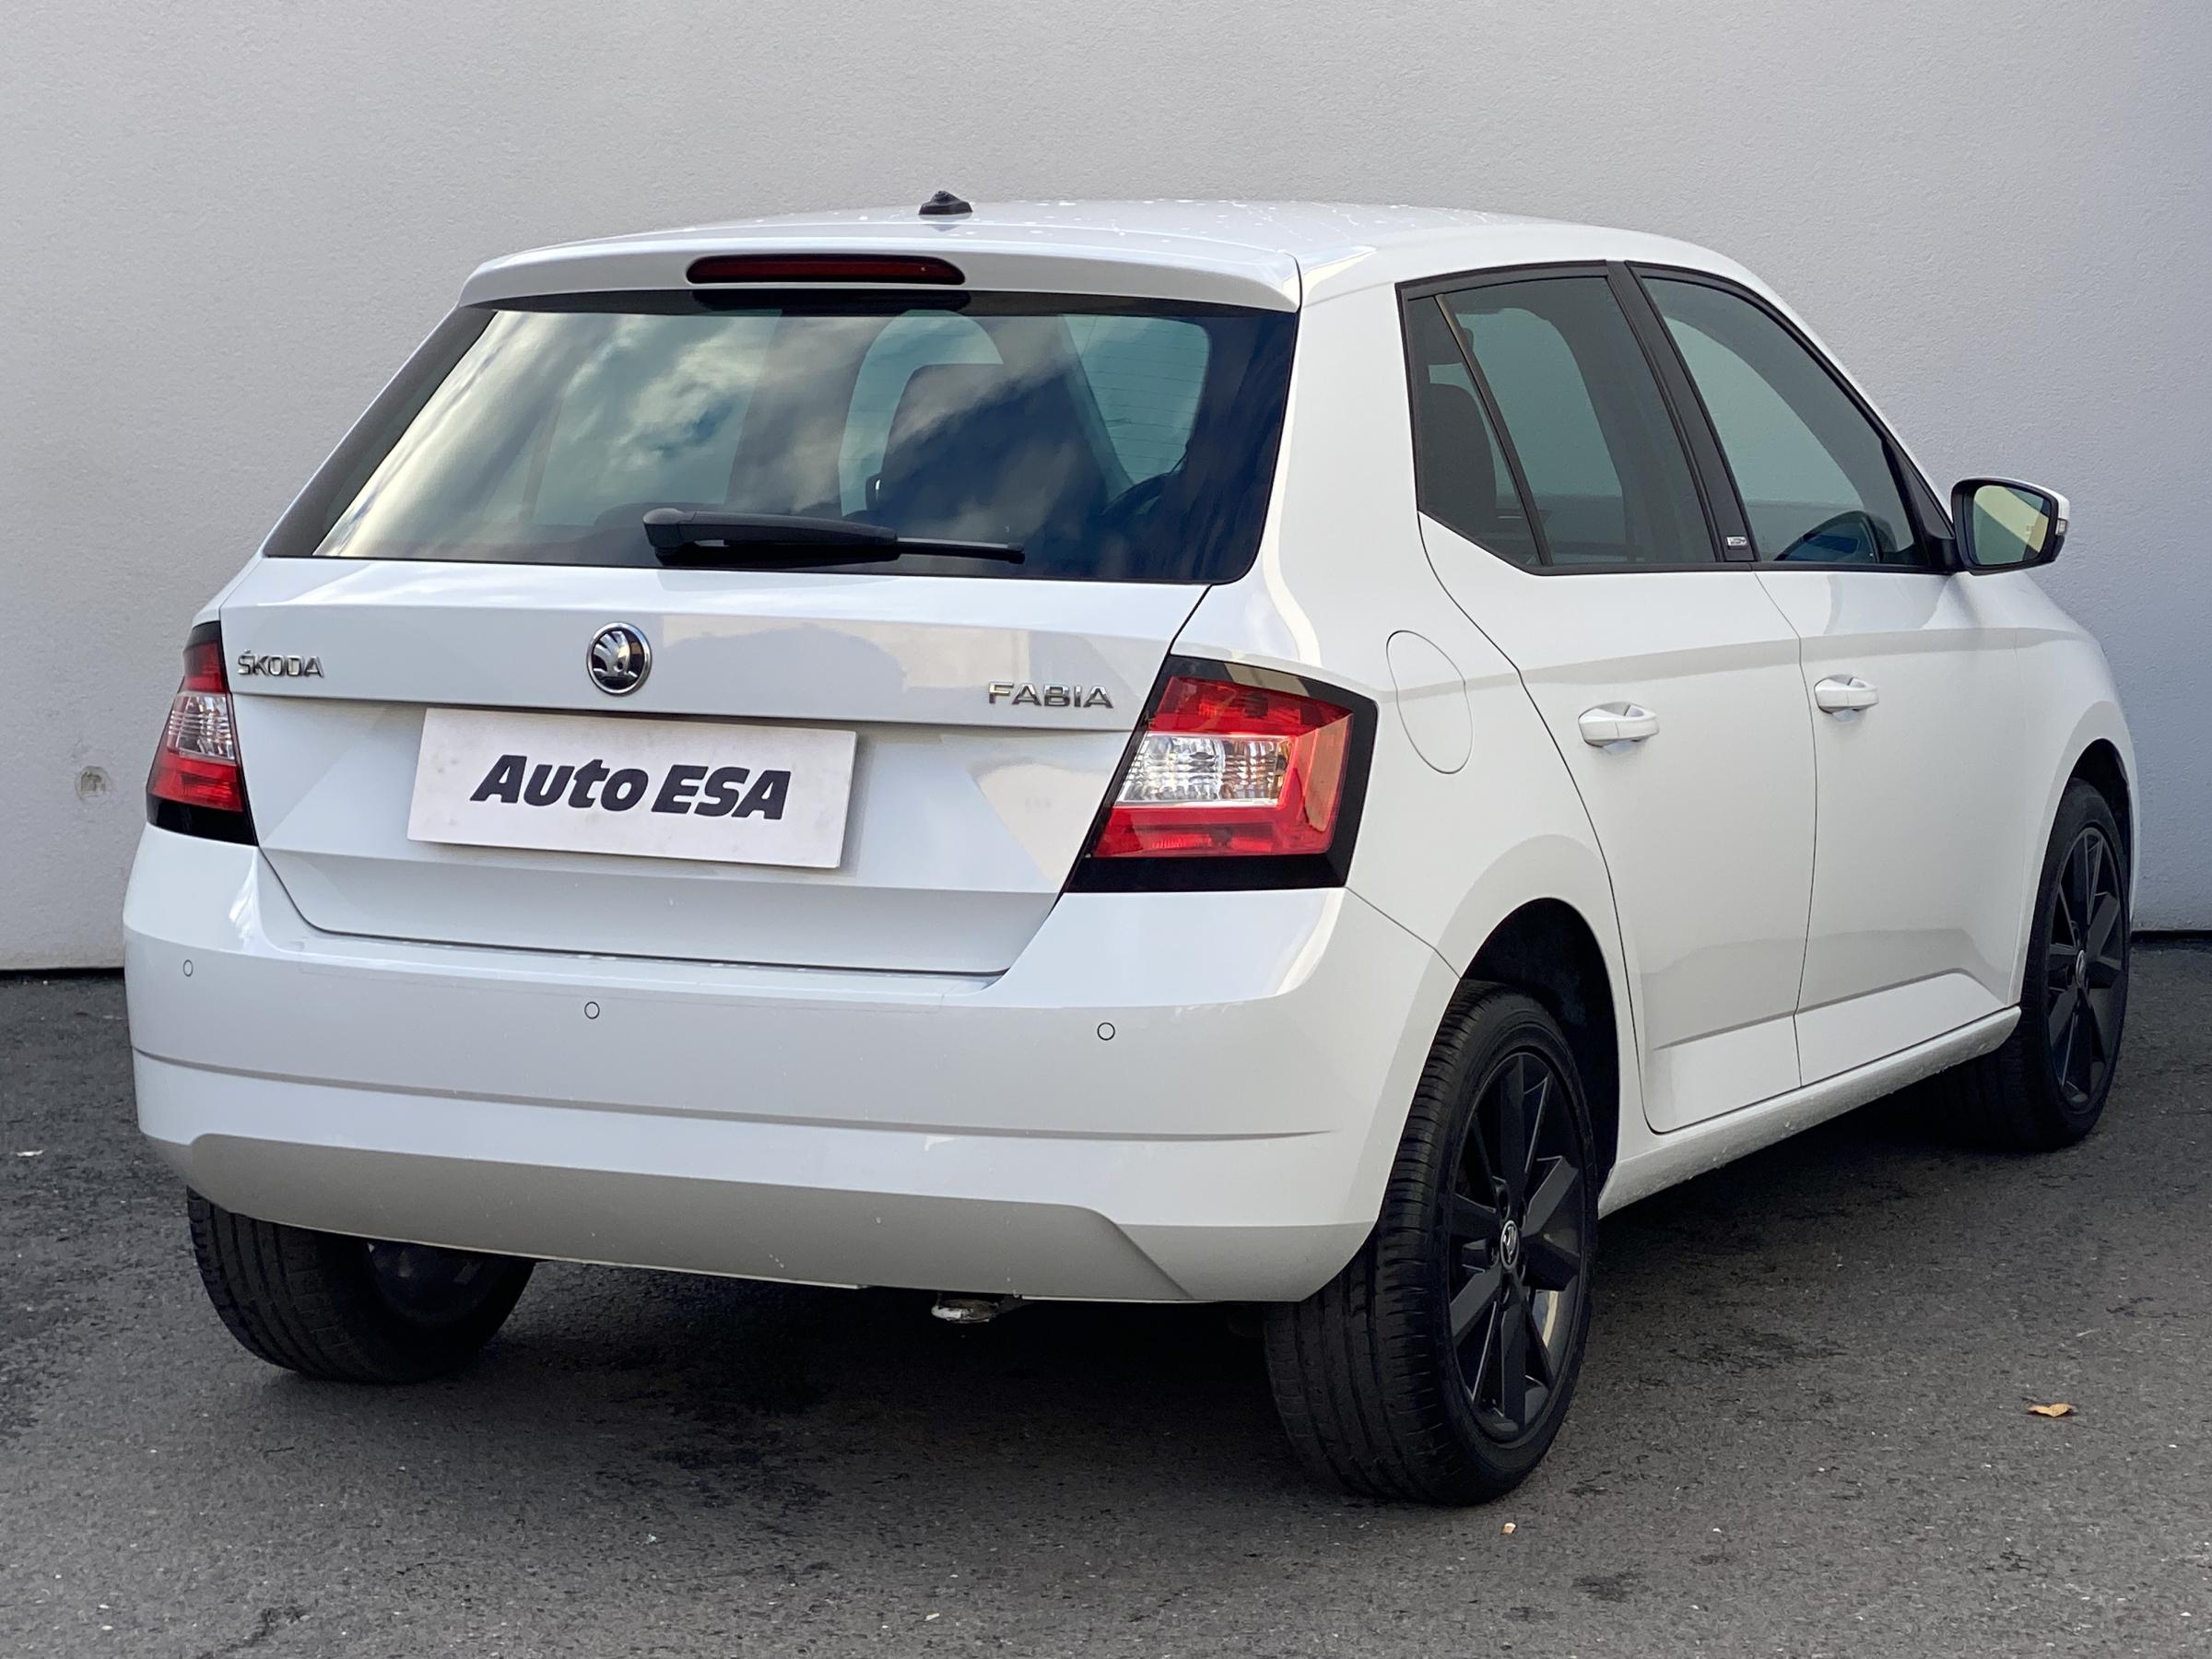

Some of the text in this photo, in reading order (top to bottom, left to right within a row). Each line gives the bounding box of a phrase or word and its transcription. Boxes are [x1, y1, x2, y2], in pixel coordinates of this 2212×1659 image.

[988, 680, 1113, 709] FABIA
[469, 754, 791, 820] Auto ESA
